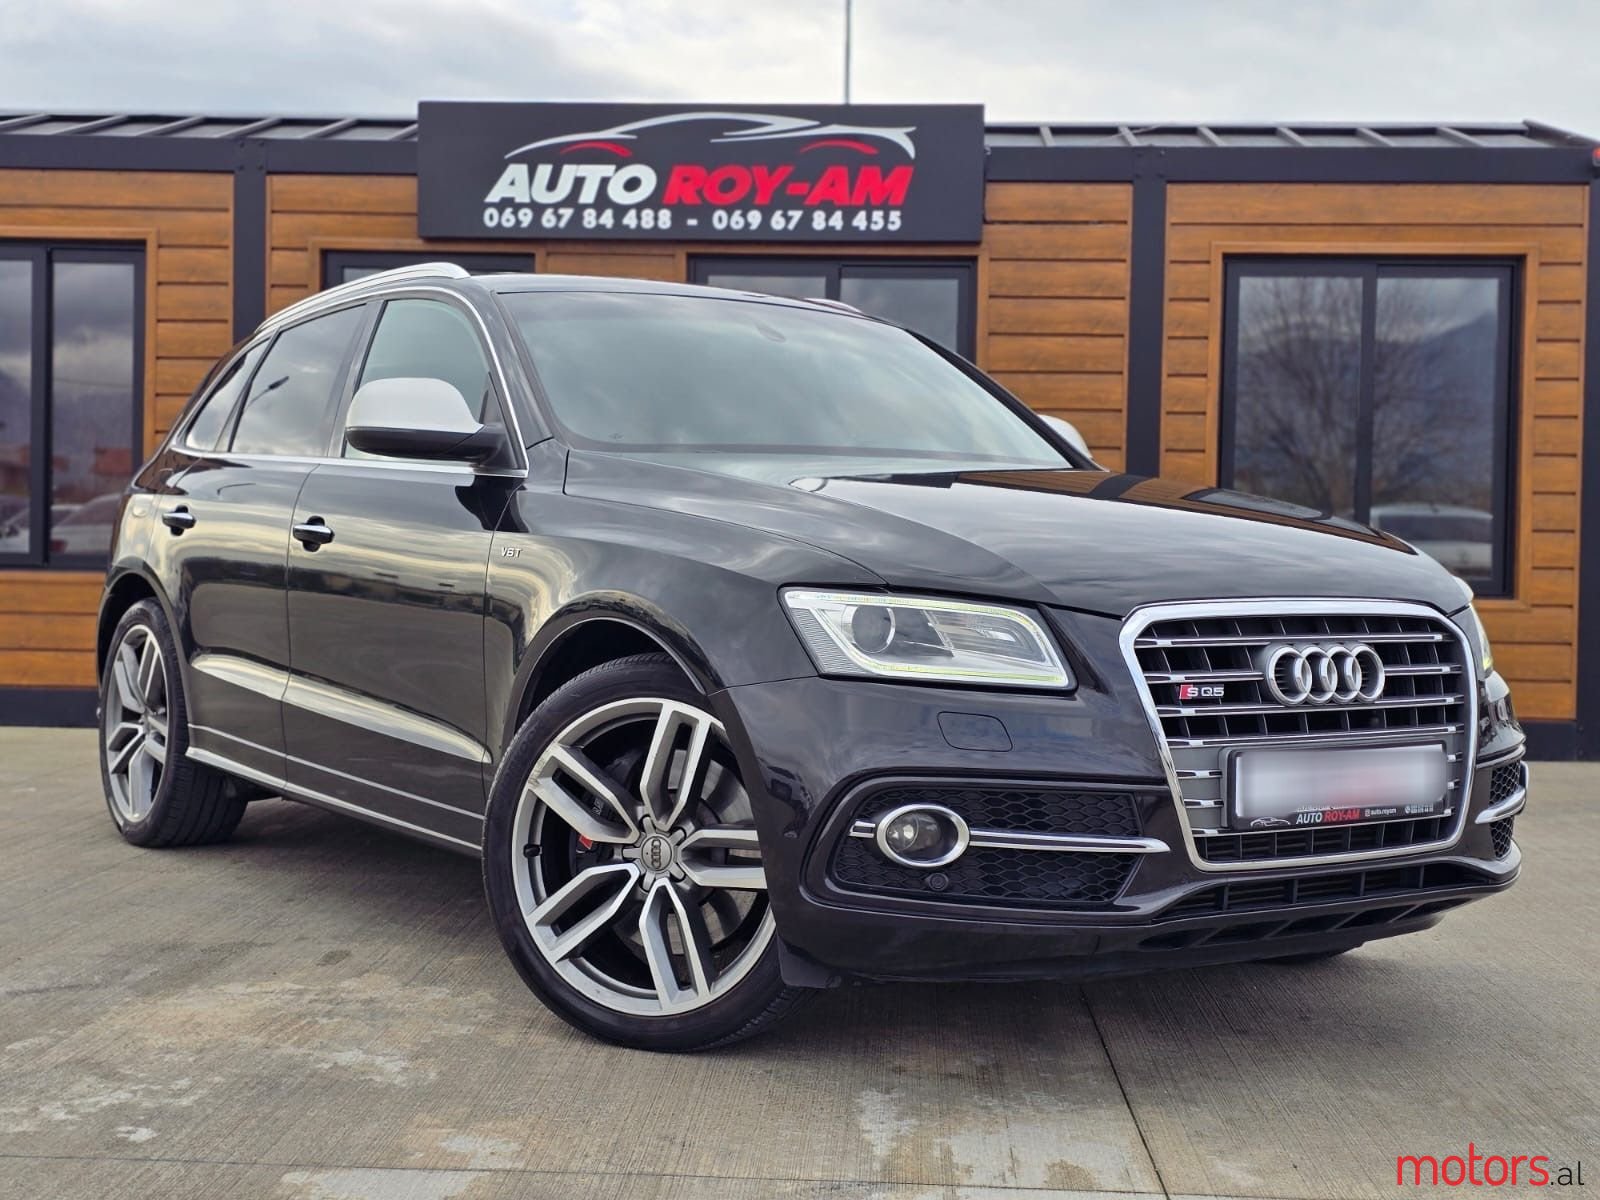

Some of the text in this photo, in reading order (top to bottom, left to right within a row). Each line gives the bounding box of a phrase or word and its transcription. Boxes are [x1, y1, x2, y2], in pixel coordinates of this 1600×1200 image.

[484, 163, 914, 206] AUTO ROY-AM
[483, 207, 534, 228] 069
[541, 208, 574, 229] 67
[582, 208, 615, 229] 84
[622, 208, 672, 230] 488
[712, 209, 762, 230] 069
[770, 209, 803, 231] 67
[811, 210, 844, 231] 84
[851, 210, 902, 231] 455
[501, 547, 522, 558] V6T
[1296, 811, 1323, 825] AUTO
